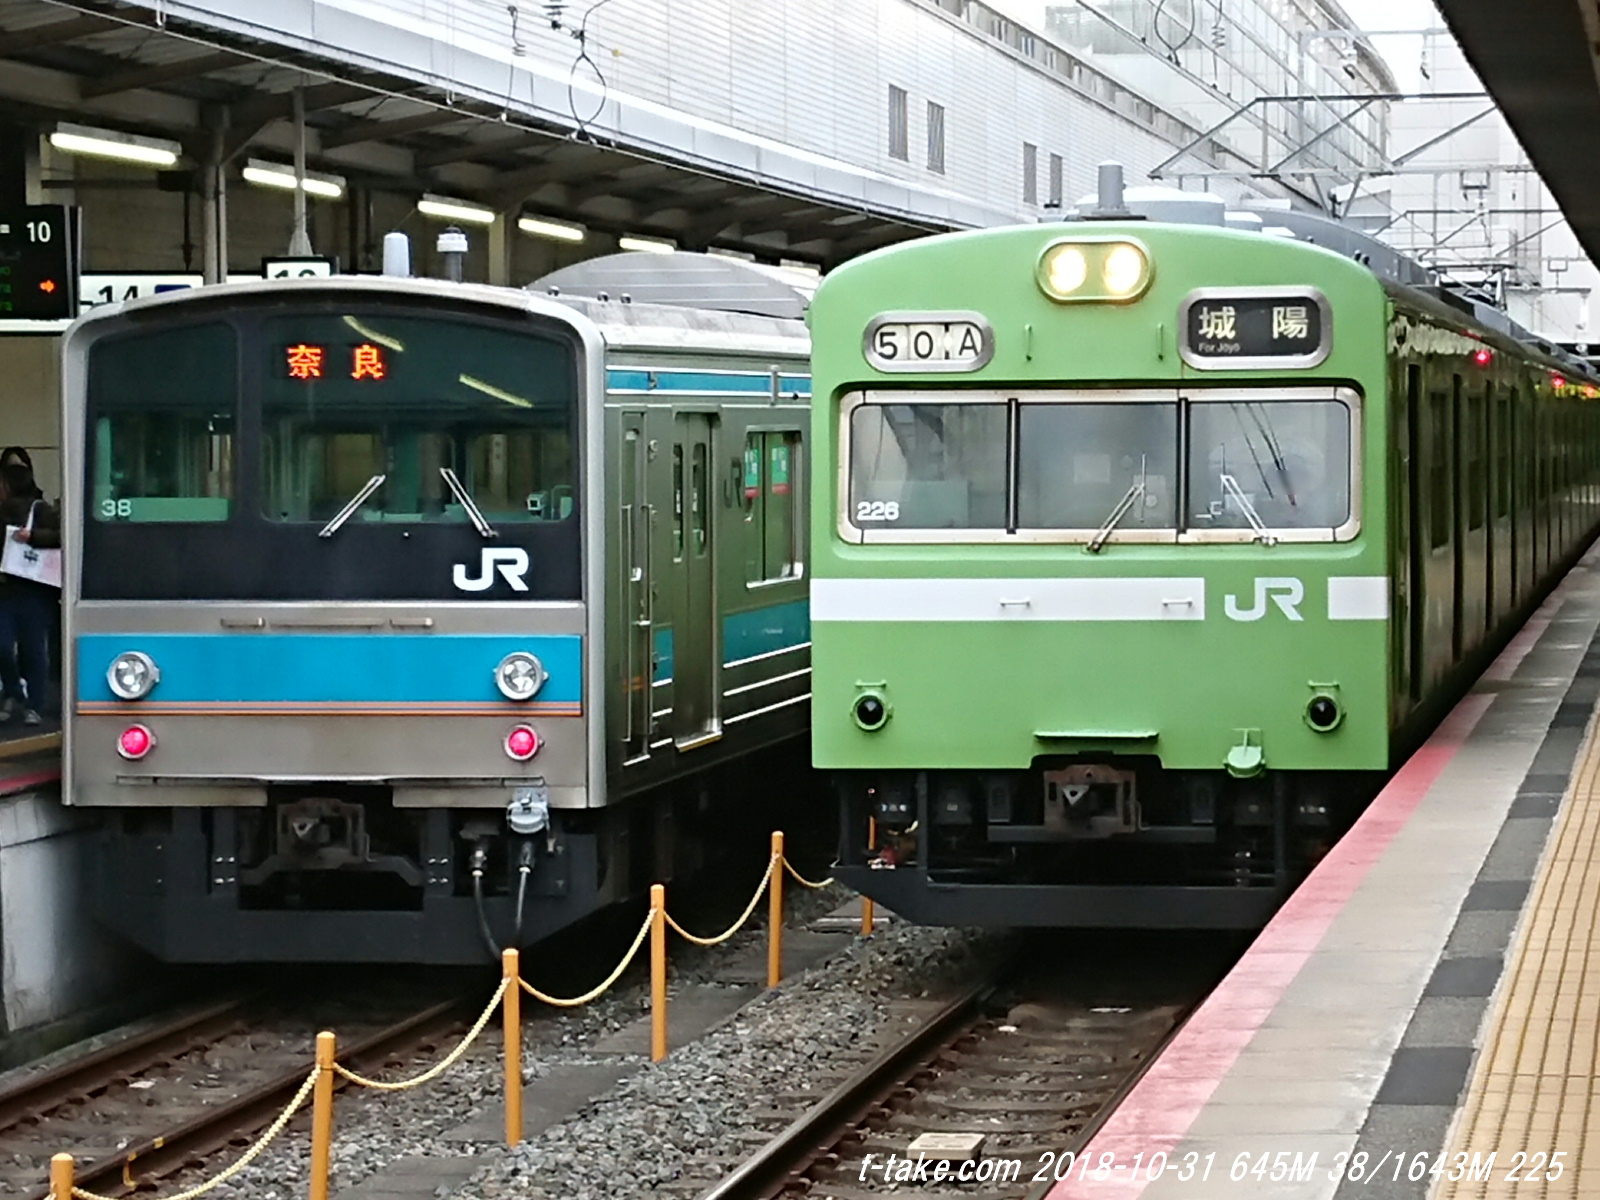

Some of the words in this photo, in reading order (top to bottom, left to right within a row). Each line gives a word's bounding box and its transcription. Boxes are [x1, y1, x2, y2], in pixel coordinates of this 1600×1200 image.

[26, 221, 51, 242] 10
[101, 499, 132, 517] 38
[856, 501, 900, 521] 226
[453, 547, 529, 592] JR
[1224, 577, 1304, 621] JR
